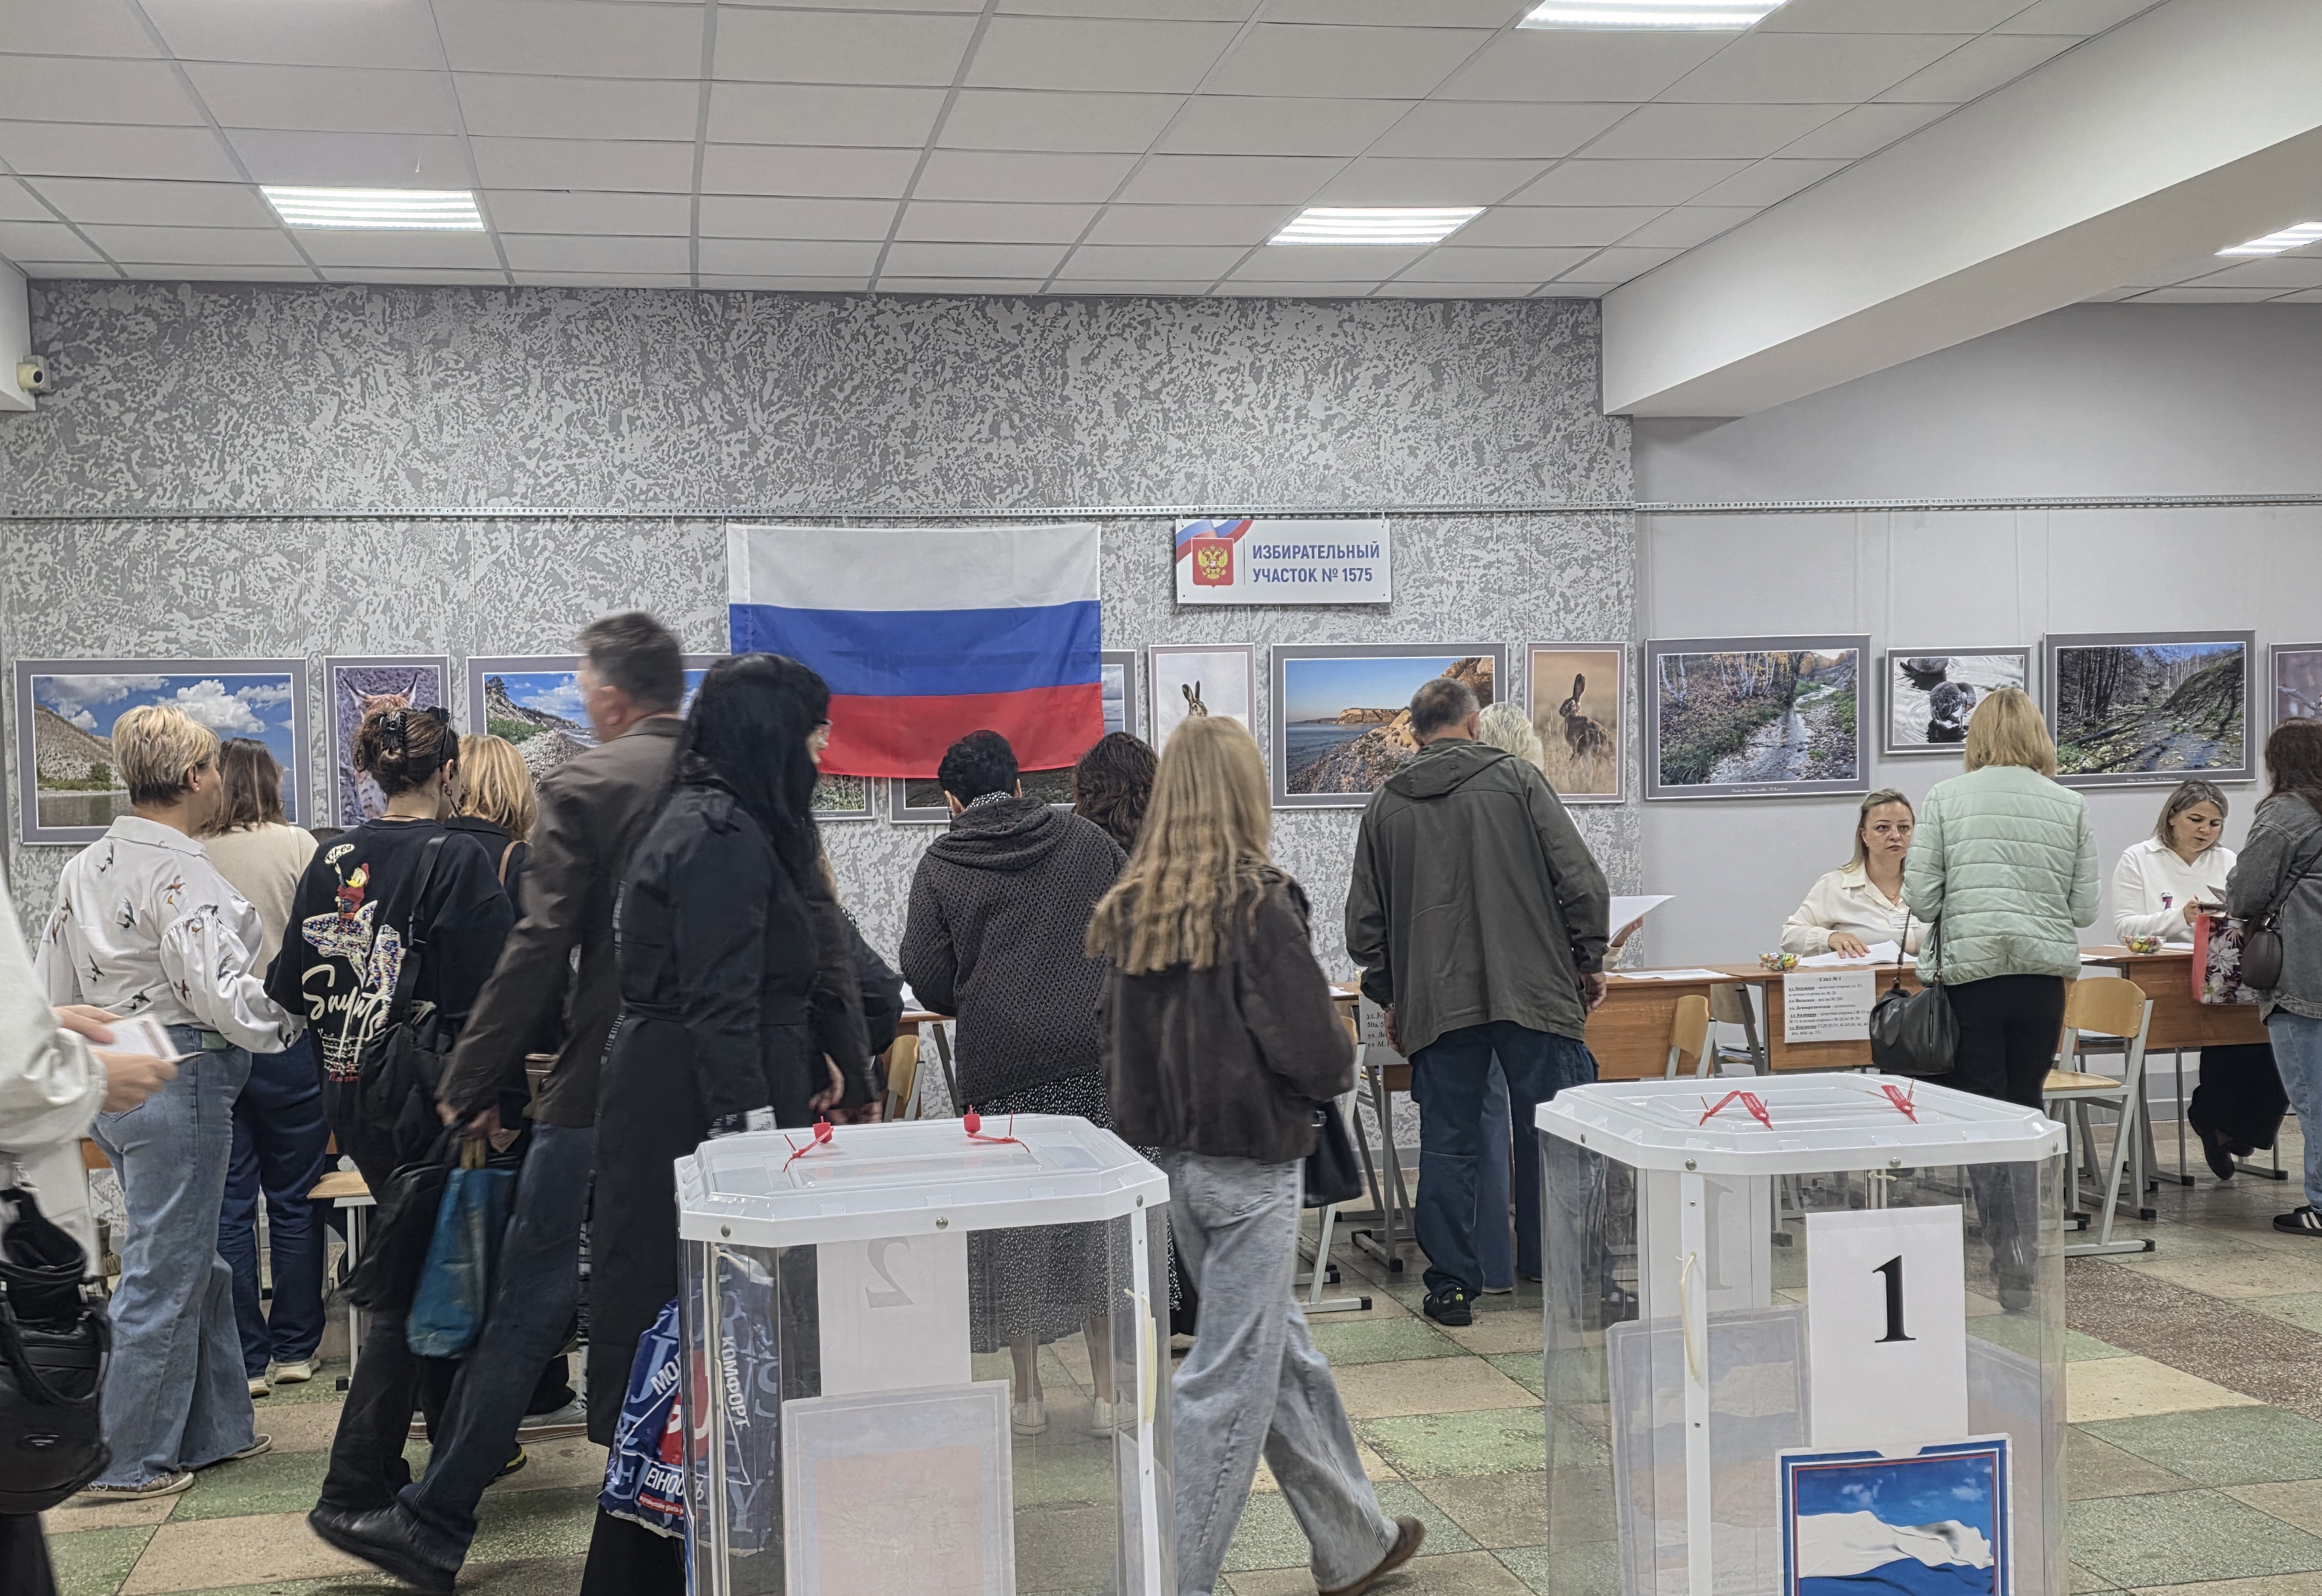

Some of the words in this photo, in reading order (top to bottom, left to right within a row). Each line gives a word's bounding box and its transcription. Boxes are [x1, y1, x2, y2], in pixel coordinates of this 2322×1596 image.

[1253, 540, 1380, 559] ИЗБИРАТЕЛЬНЫЙ
[1253, 568, 1317, 583] УЧАСТОК
[1322, 568, 1339, 582] №
[1342, 568, 1373, 582] 1575
[1872, 1255, 1917, 1344] 1
[650, 1352, 681, 1395] МО
[722, 1336, 750, 1428] КОМФОРТ
